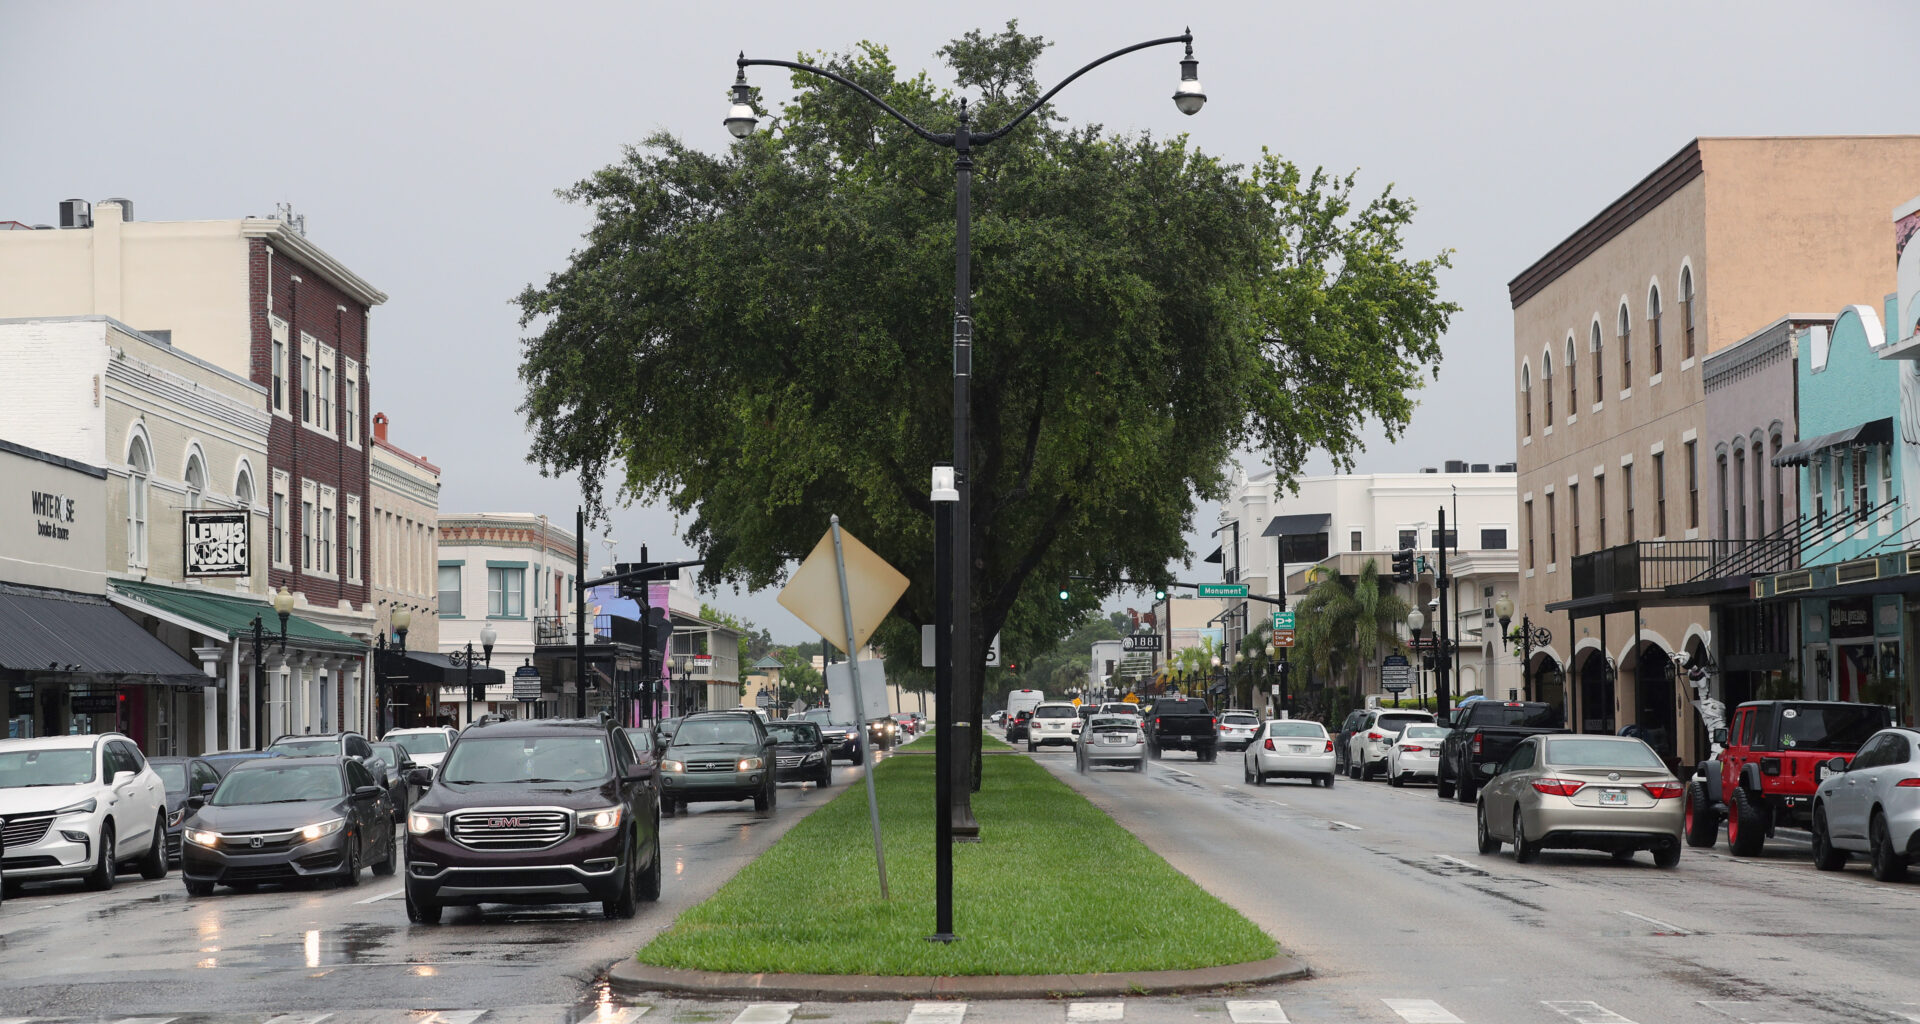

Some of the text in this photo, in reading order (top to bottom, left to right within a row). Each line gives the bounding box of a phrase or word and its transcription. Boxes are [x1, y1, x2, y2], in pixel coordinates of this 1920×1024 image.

[32, 490, 54, 518] WHITE
[38, 519, 69, 540] books & more
[189, 522, 245, 544] LEWIS
[189, 543, 246, 565] MUSIC
[1204, 587, 1242, 595] Monument
[1133, 637, 1160, 647] 1881
[488, 816, 530, 828] GMC
